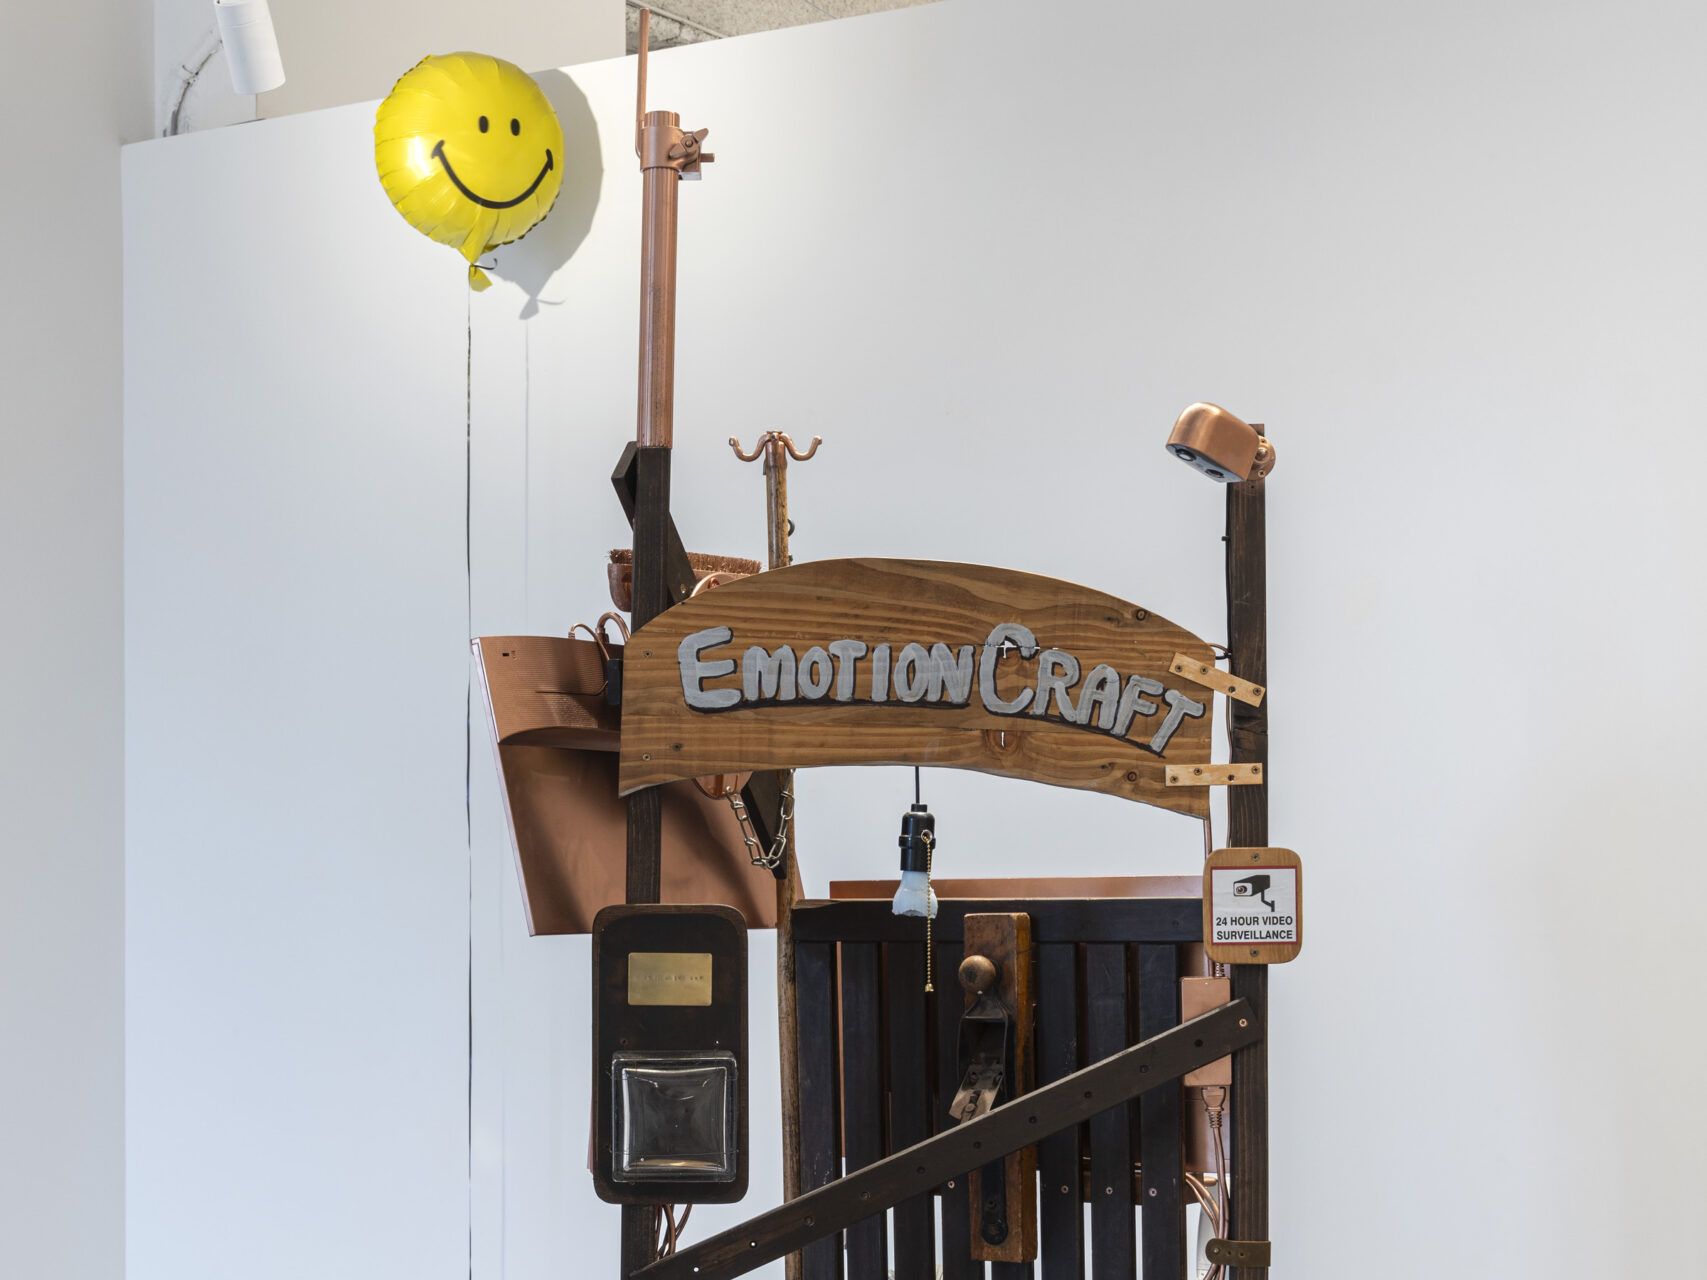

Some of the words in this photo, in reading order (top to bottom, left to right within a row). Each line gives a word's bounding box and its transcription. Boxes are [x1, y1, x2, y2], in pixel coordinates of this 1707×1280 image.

[1216, 917, 1228, 926] 24
[1230, 916, 1259, 926] HOUR
[1262, 916, 1293, 925] VIDEO
[1216, 930, 1293, 941] SURVEILLANCE
